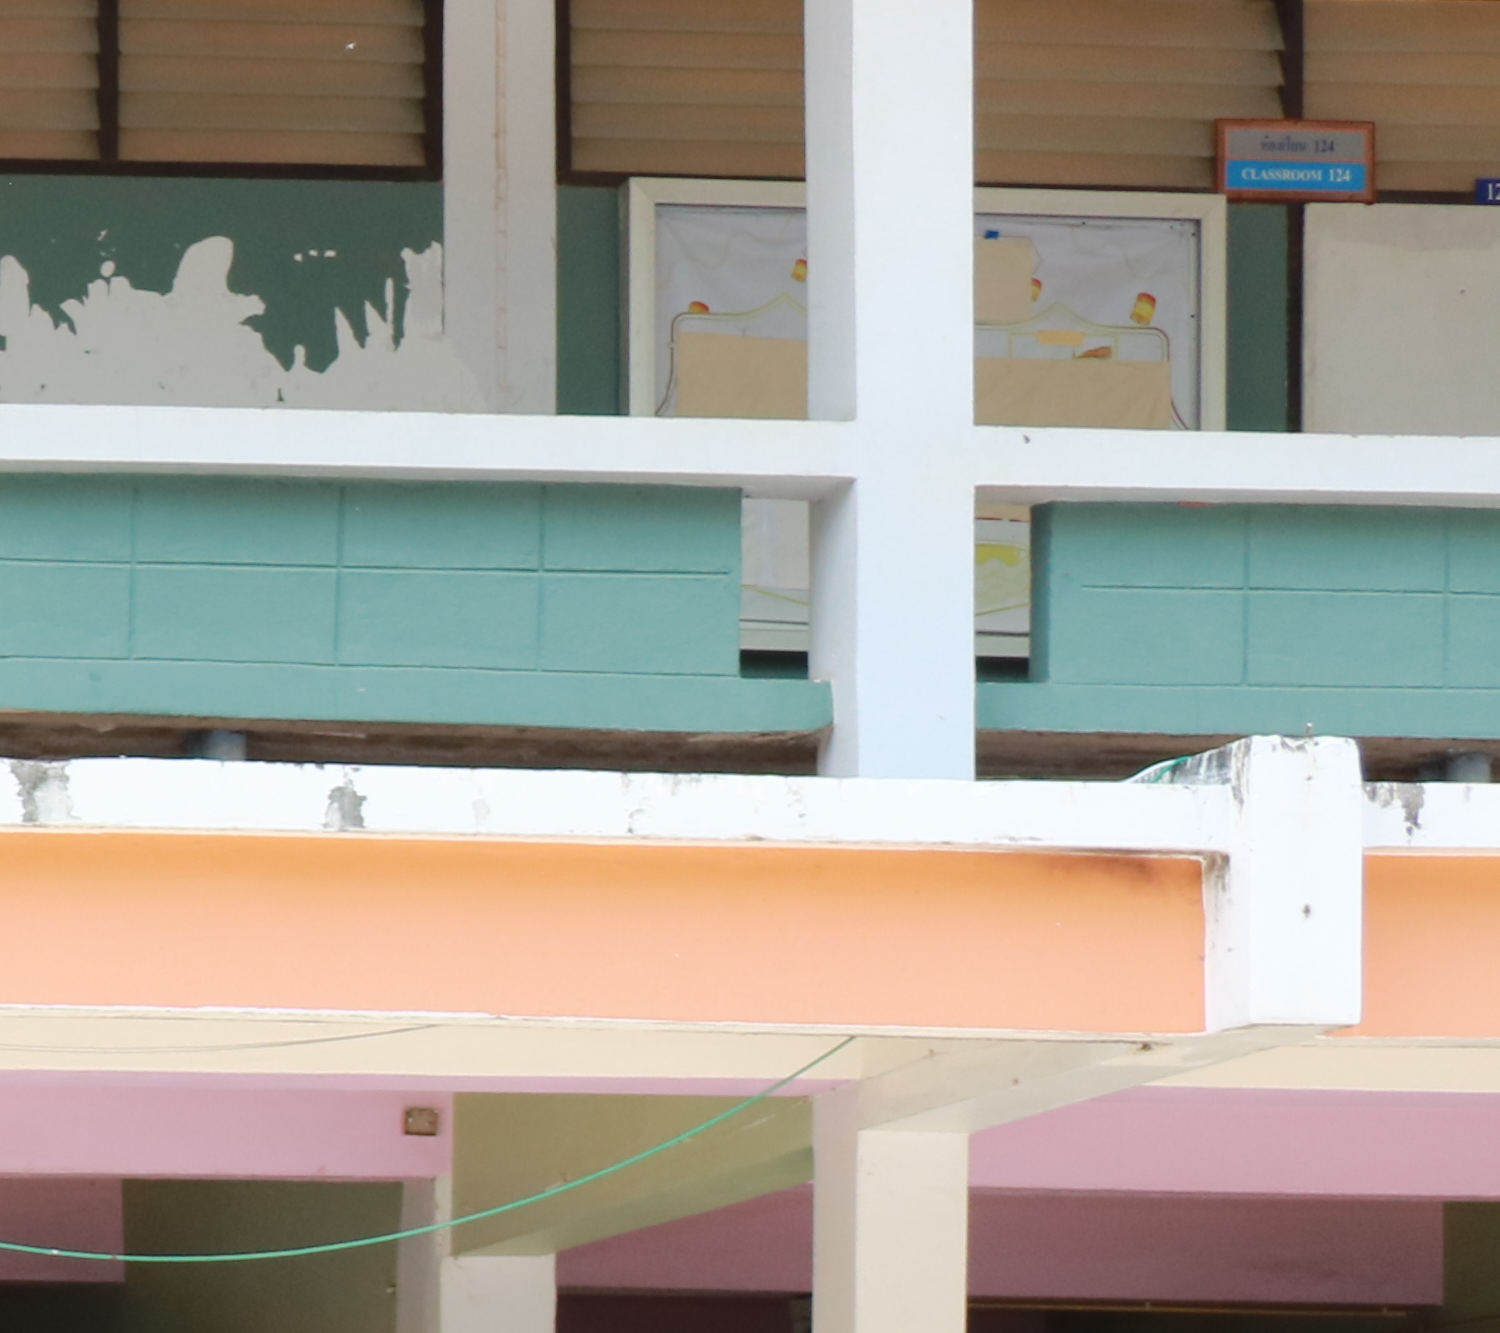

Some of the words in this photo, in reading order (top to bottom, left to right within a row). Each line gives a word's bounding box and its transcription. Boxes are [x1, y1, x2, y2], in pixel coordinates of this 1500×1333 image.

[1314, 140, 1335, 153] 124
[1241, 168, 1322, 181] CLASSROOM
[1329, 168, 1352, 182] 124
